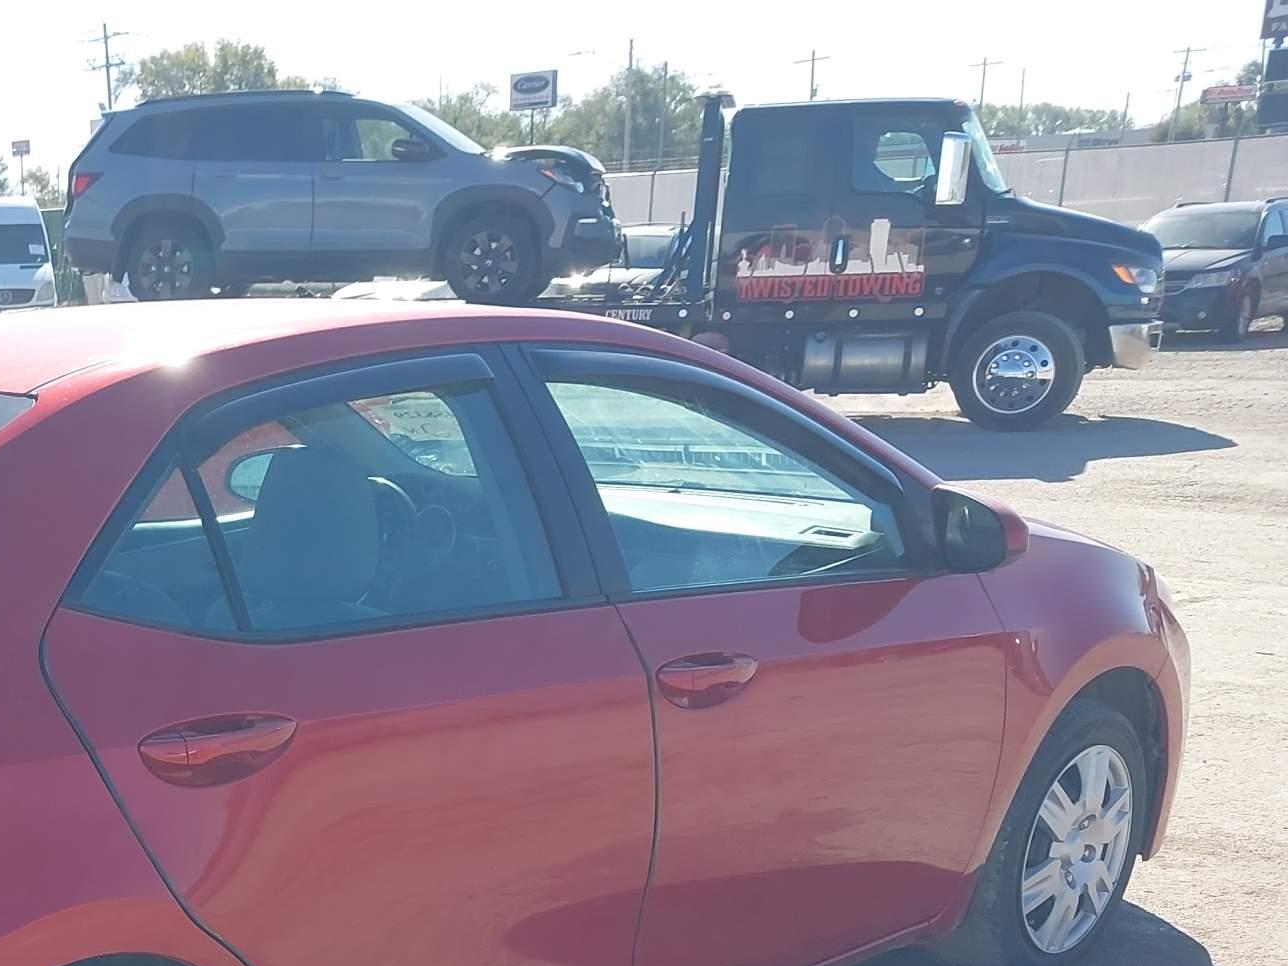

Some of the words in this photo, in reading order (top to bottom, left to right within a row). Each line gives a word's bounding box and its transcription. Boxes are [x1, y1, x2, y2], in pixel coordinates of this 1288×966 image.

[738, 275, 831, 298] TWISTED
[833, 273, 923, 297] TOWING
[604, 308, 653, 321] CENTURY
